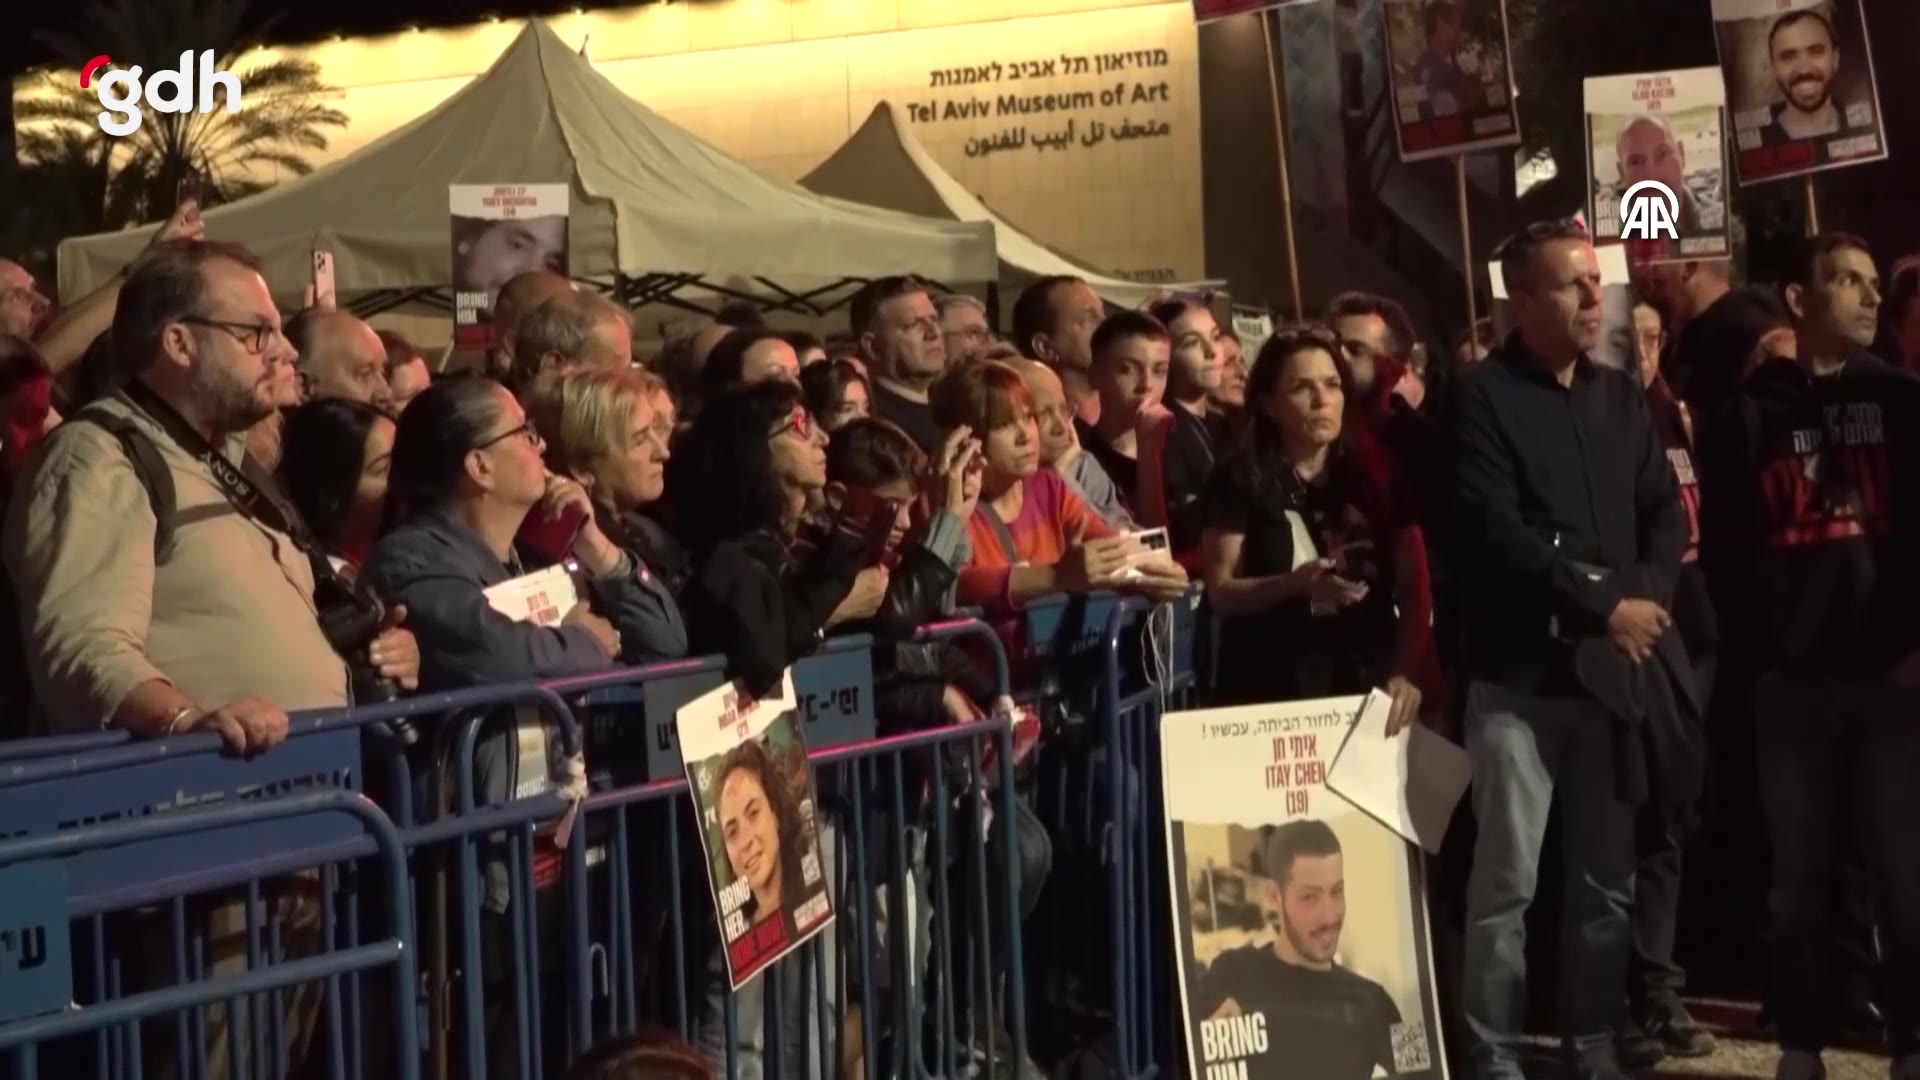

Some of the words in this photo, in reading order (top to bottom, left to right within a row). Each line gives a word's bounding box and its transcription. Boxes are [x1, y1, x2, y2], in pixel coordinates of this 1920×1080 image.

[930, 61, 1003, 87] לאמנות
[1008, 59, 1055, 80] אביב
[1060, 53, 1089, 75] תל
[1095, 48, 1168, 75] מוזיאון
[907, 102, 937, 123] Tel
[943, 98, 990, 121] Aviv
[996, 90, 1094, 116] Museum
[1100, 83, 1125, 106] of
[1131, 82, 1169, 102] Art
[964, 127, 1026, 157] للفنون
[1030, 118, 1074, 152] أبيب
[1081, 121, 1104, 147] تل
[1110, 118, 1170, 140] متحف
[456, 291, 488, 309] BRING
[457, 308, 478, 325] HIM
[200, 450, 251, 496] SONY
[1211, 721, 1249, 738] עכשיו
[1304, 709, 1341, 728] לחזור
[1272, 736, 1286, 763] חן
[1290, 734, 1318, 759] איתי
[1265, 764, 1291, 789] ITAY
[1294, 760, 1326, 786] CHEN
[1286, 788, 1309, 816] (19)
[719, 874, 751, 917] BRING
[1200, 1011, 1269, 1063] BRING
